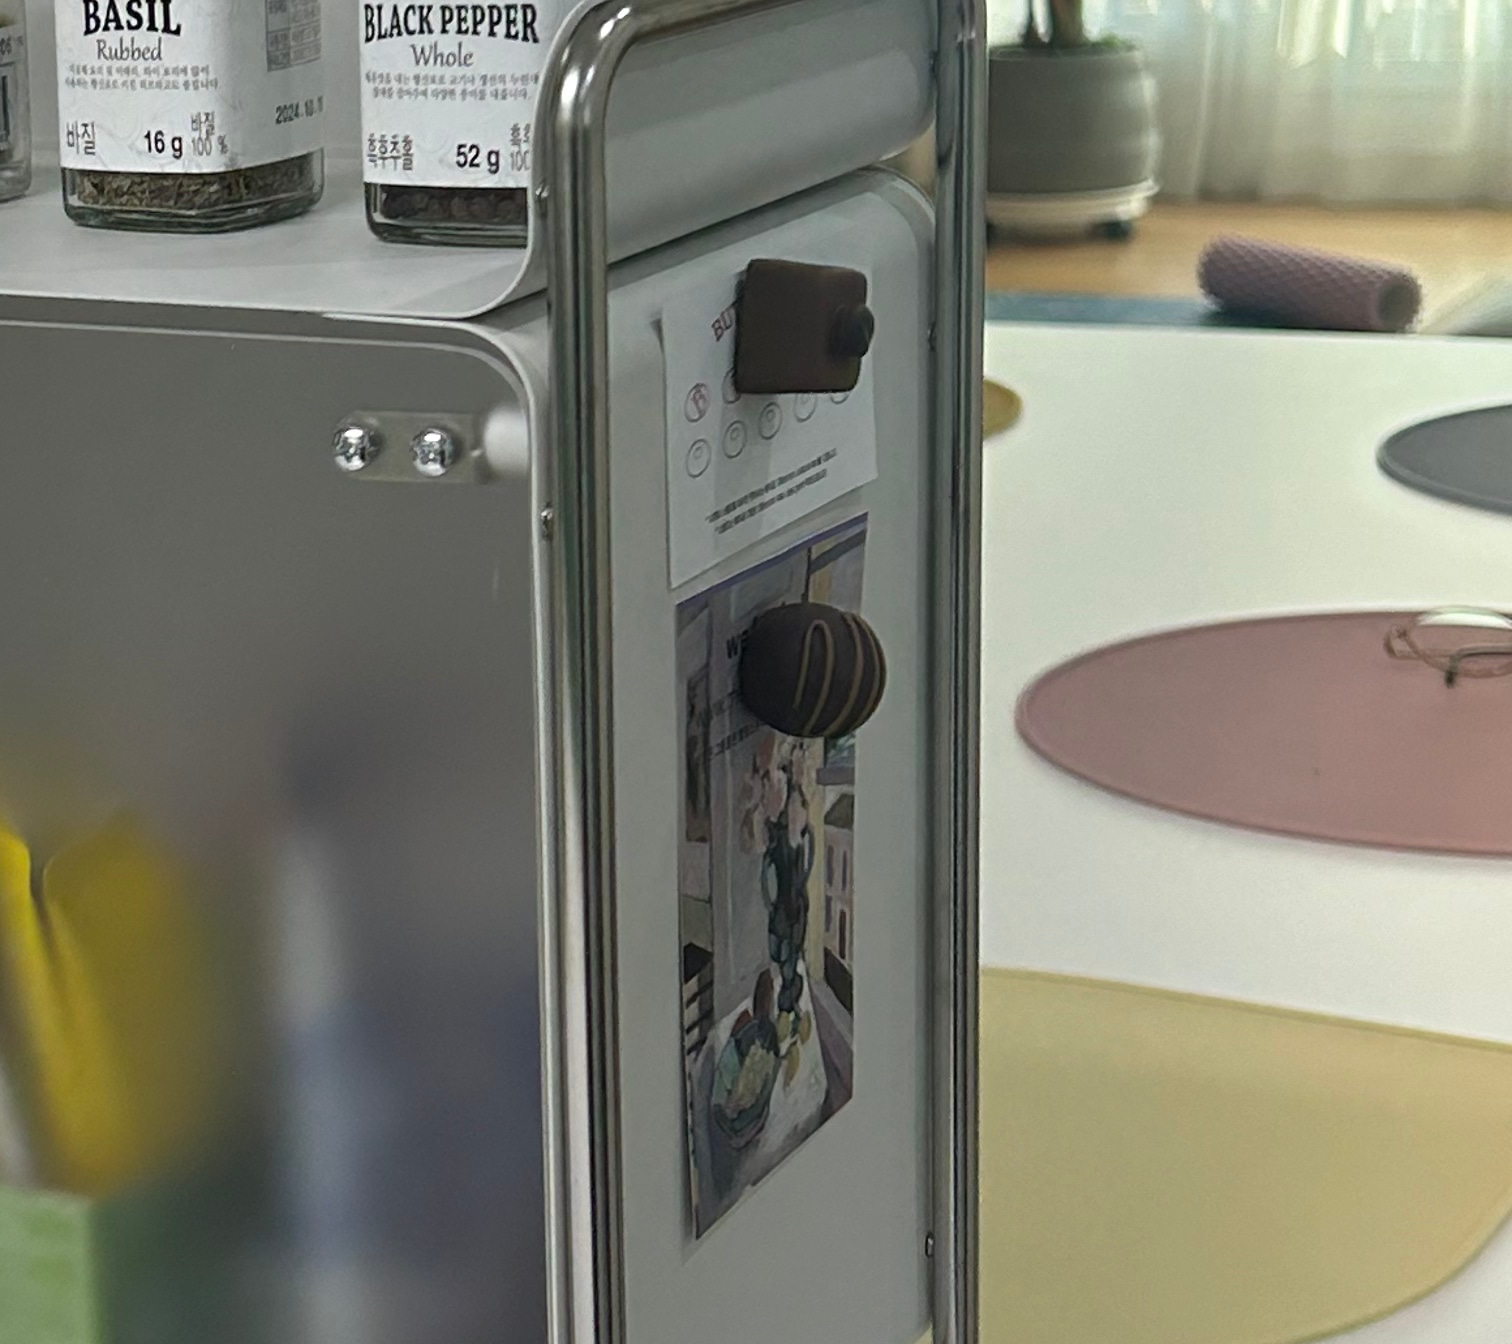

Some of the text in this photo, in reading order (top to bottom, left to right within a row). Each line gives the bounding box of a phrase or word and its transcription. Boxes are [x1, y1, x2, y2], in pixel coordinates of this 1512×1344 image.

[364, 2, 540, 44] BLACK PEPPER
[96, 36, 163, 61] Rubbed
[410, 41, 474, 67] Whole
[66, 119, 96, 156] 바질
[190, 110, 216, 138] 바질
[143, 129, 183, 160] 16 g
[191, 135, 213, 157] 100
[366, 132, 414, 171] 흑후추홀
[455, 143, 501, 175] 52 g
